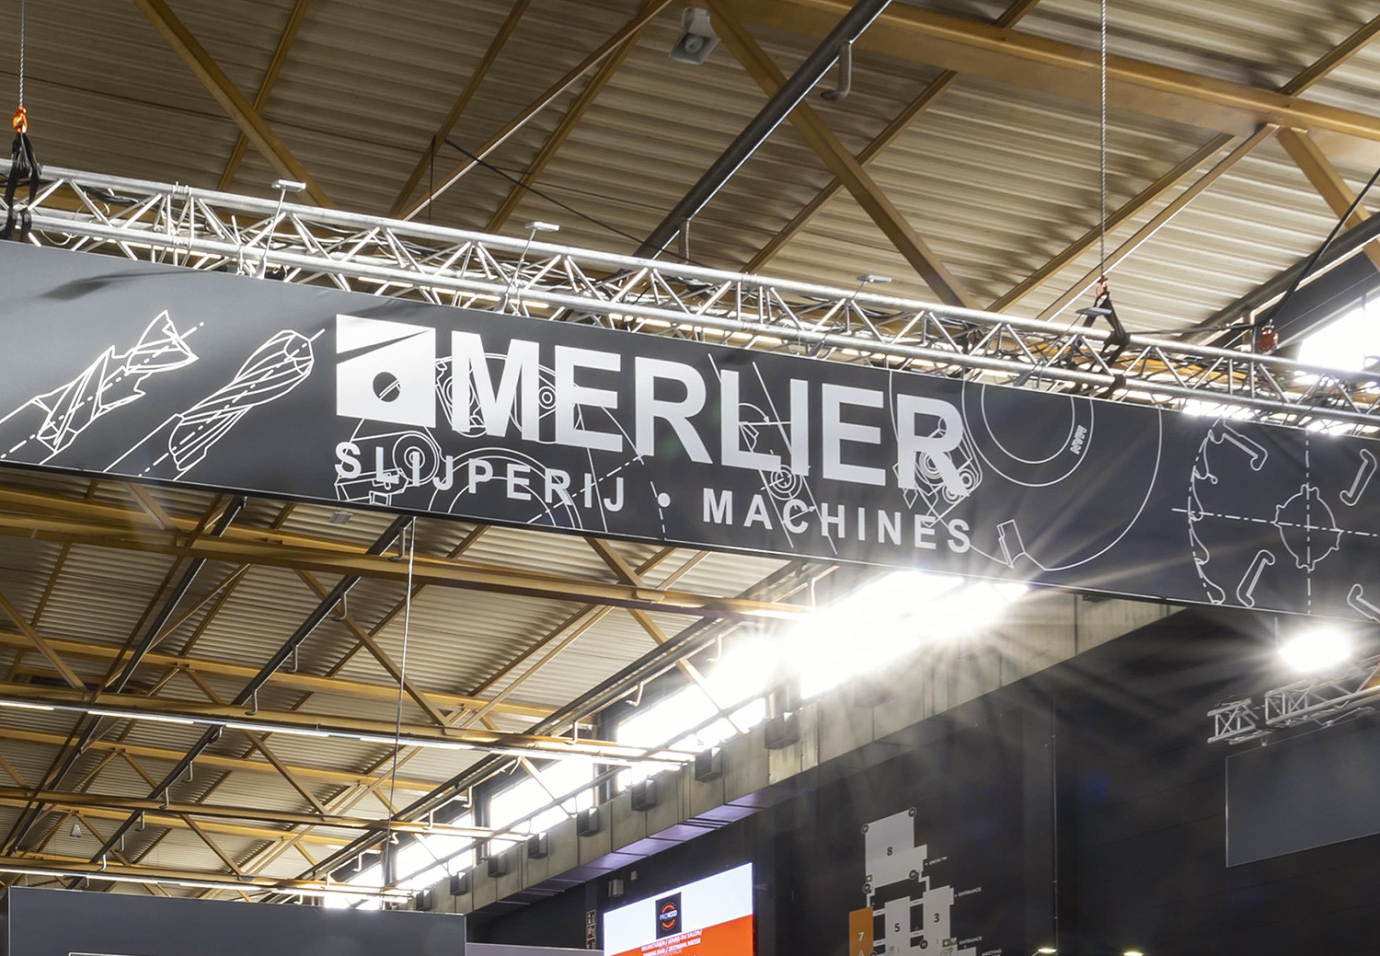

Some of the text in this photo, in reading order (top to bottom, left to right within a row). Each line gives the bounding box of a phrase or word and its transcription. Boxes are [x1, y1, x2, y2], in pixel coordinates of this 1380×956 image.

[451, 330, 969, 498] MERLIER
[334, 441, 973, 554] SLIJPERIJ MACHINES
[934, 913, 940, 922] 3
[894, 923, 900, 932] 5
[858, 931, 864, 941] 7
